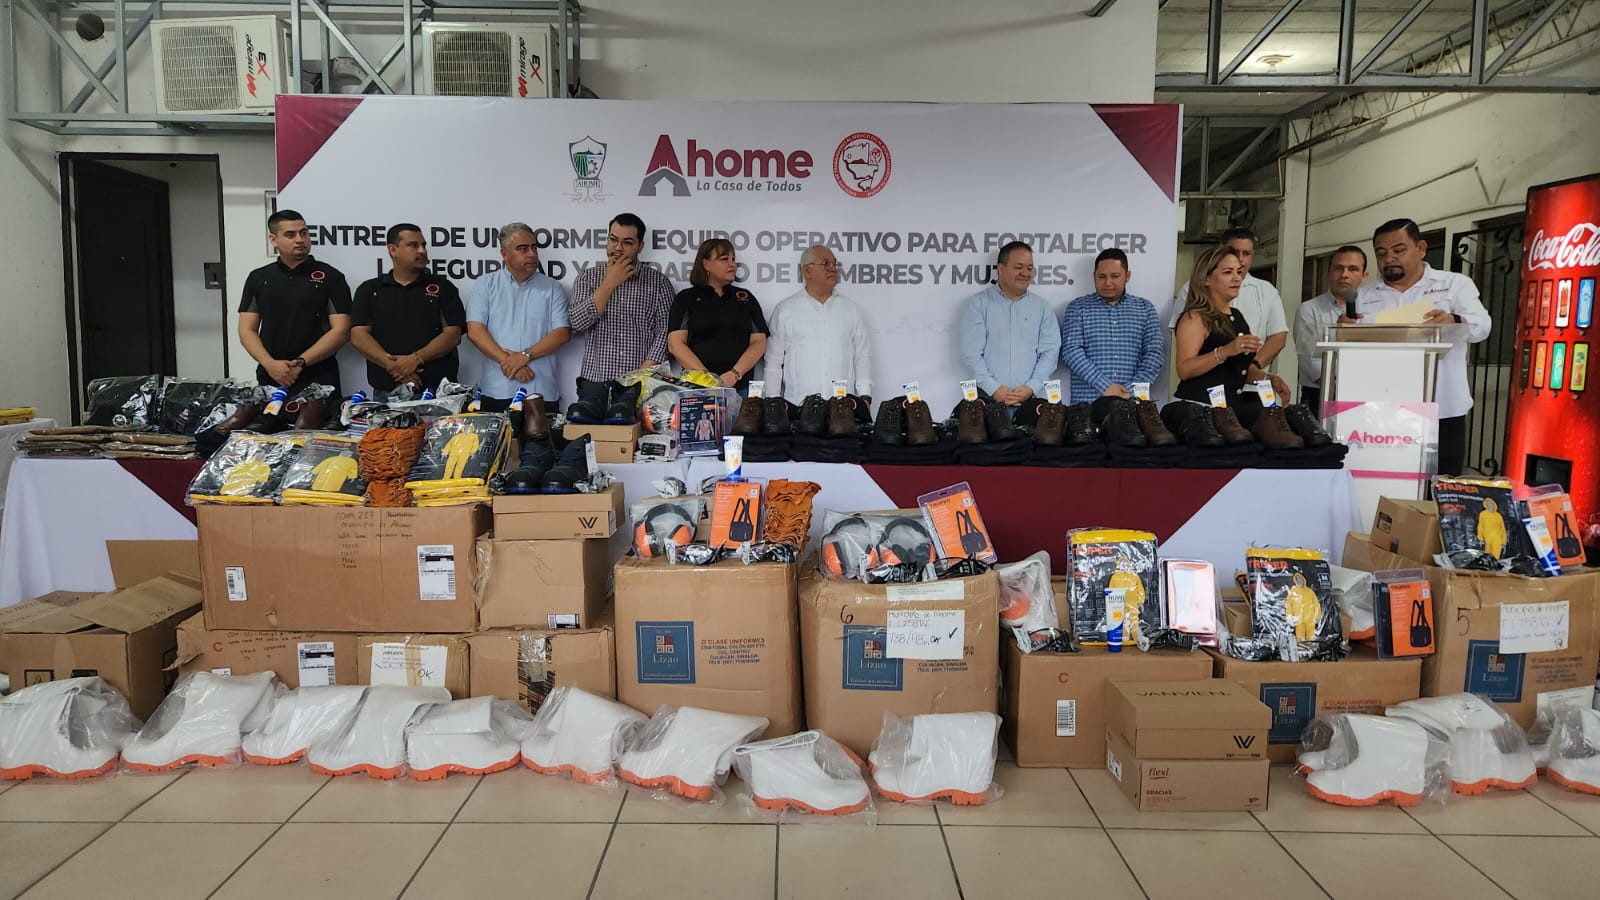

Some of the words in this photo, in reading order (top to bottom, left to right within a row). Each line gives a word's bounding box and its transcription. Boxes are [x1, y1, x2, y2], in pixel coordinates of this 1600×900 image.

[638, 134, 814, 196] Ahome
[696, 180, 710, 191] La
[714, 180, 743, 192] Casa
[747, 180, 762, 192] de
[766, 180, 802, 192] Todos
[308, 225, 388, 247] ENTRE
[430, 226, 467, 248] DE
[908, 231, 978, 254] PARA
[1528, 222, 1600, 271] Coca-Cola
[757, 262, 791, 283] DE
[924, 264, 946, 285] Y
[1347, 430, 1413, 445] Ahome
[1436, 482, 1479, 494] TRUPER
[840, 605, 854, 625] 6
[1457, 607, 1471, 637] 5
[213, 641, 223, 652] C
[417, 668, 434, 681] OK
[1058, 672, 1069, 683] C
[1148, 767, 1170, 777] flexi
